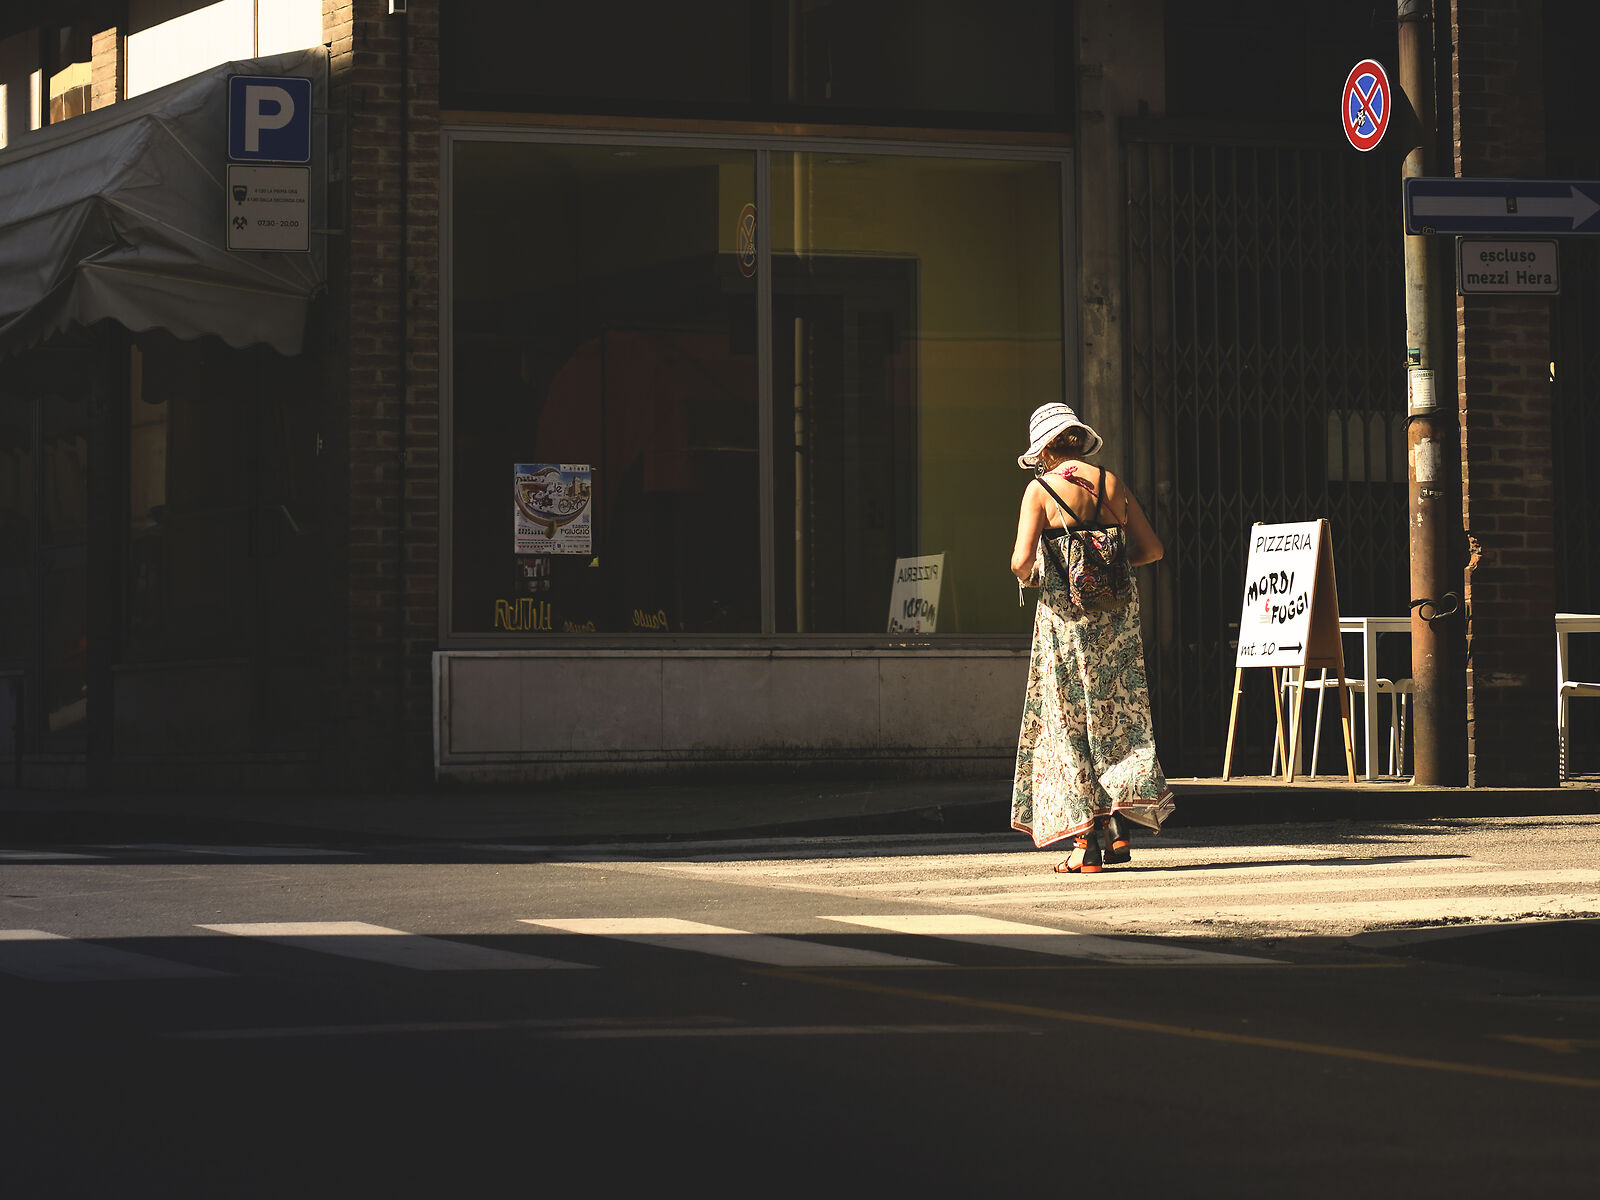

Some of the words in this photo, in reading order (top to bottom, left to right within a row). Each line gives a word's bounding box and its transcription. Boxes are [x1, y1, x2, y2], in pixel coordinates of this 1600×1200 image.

[244, 84, 295, 152] P
[1479, 247, 1537, 262] escluso
[1467, 270, 1509, 285] mezzi
[1516, 270, 1552, 285] Hera
[1255, 533, 1312, 553] PIZZERIA
[1247, 569, 1295, 607] MORDI
[1271, 591, 1309, 624] FUGGI
[1260, 642, 1276, 656] 10
